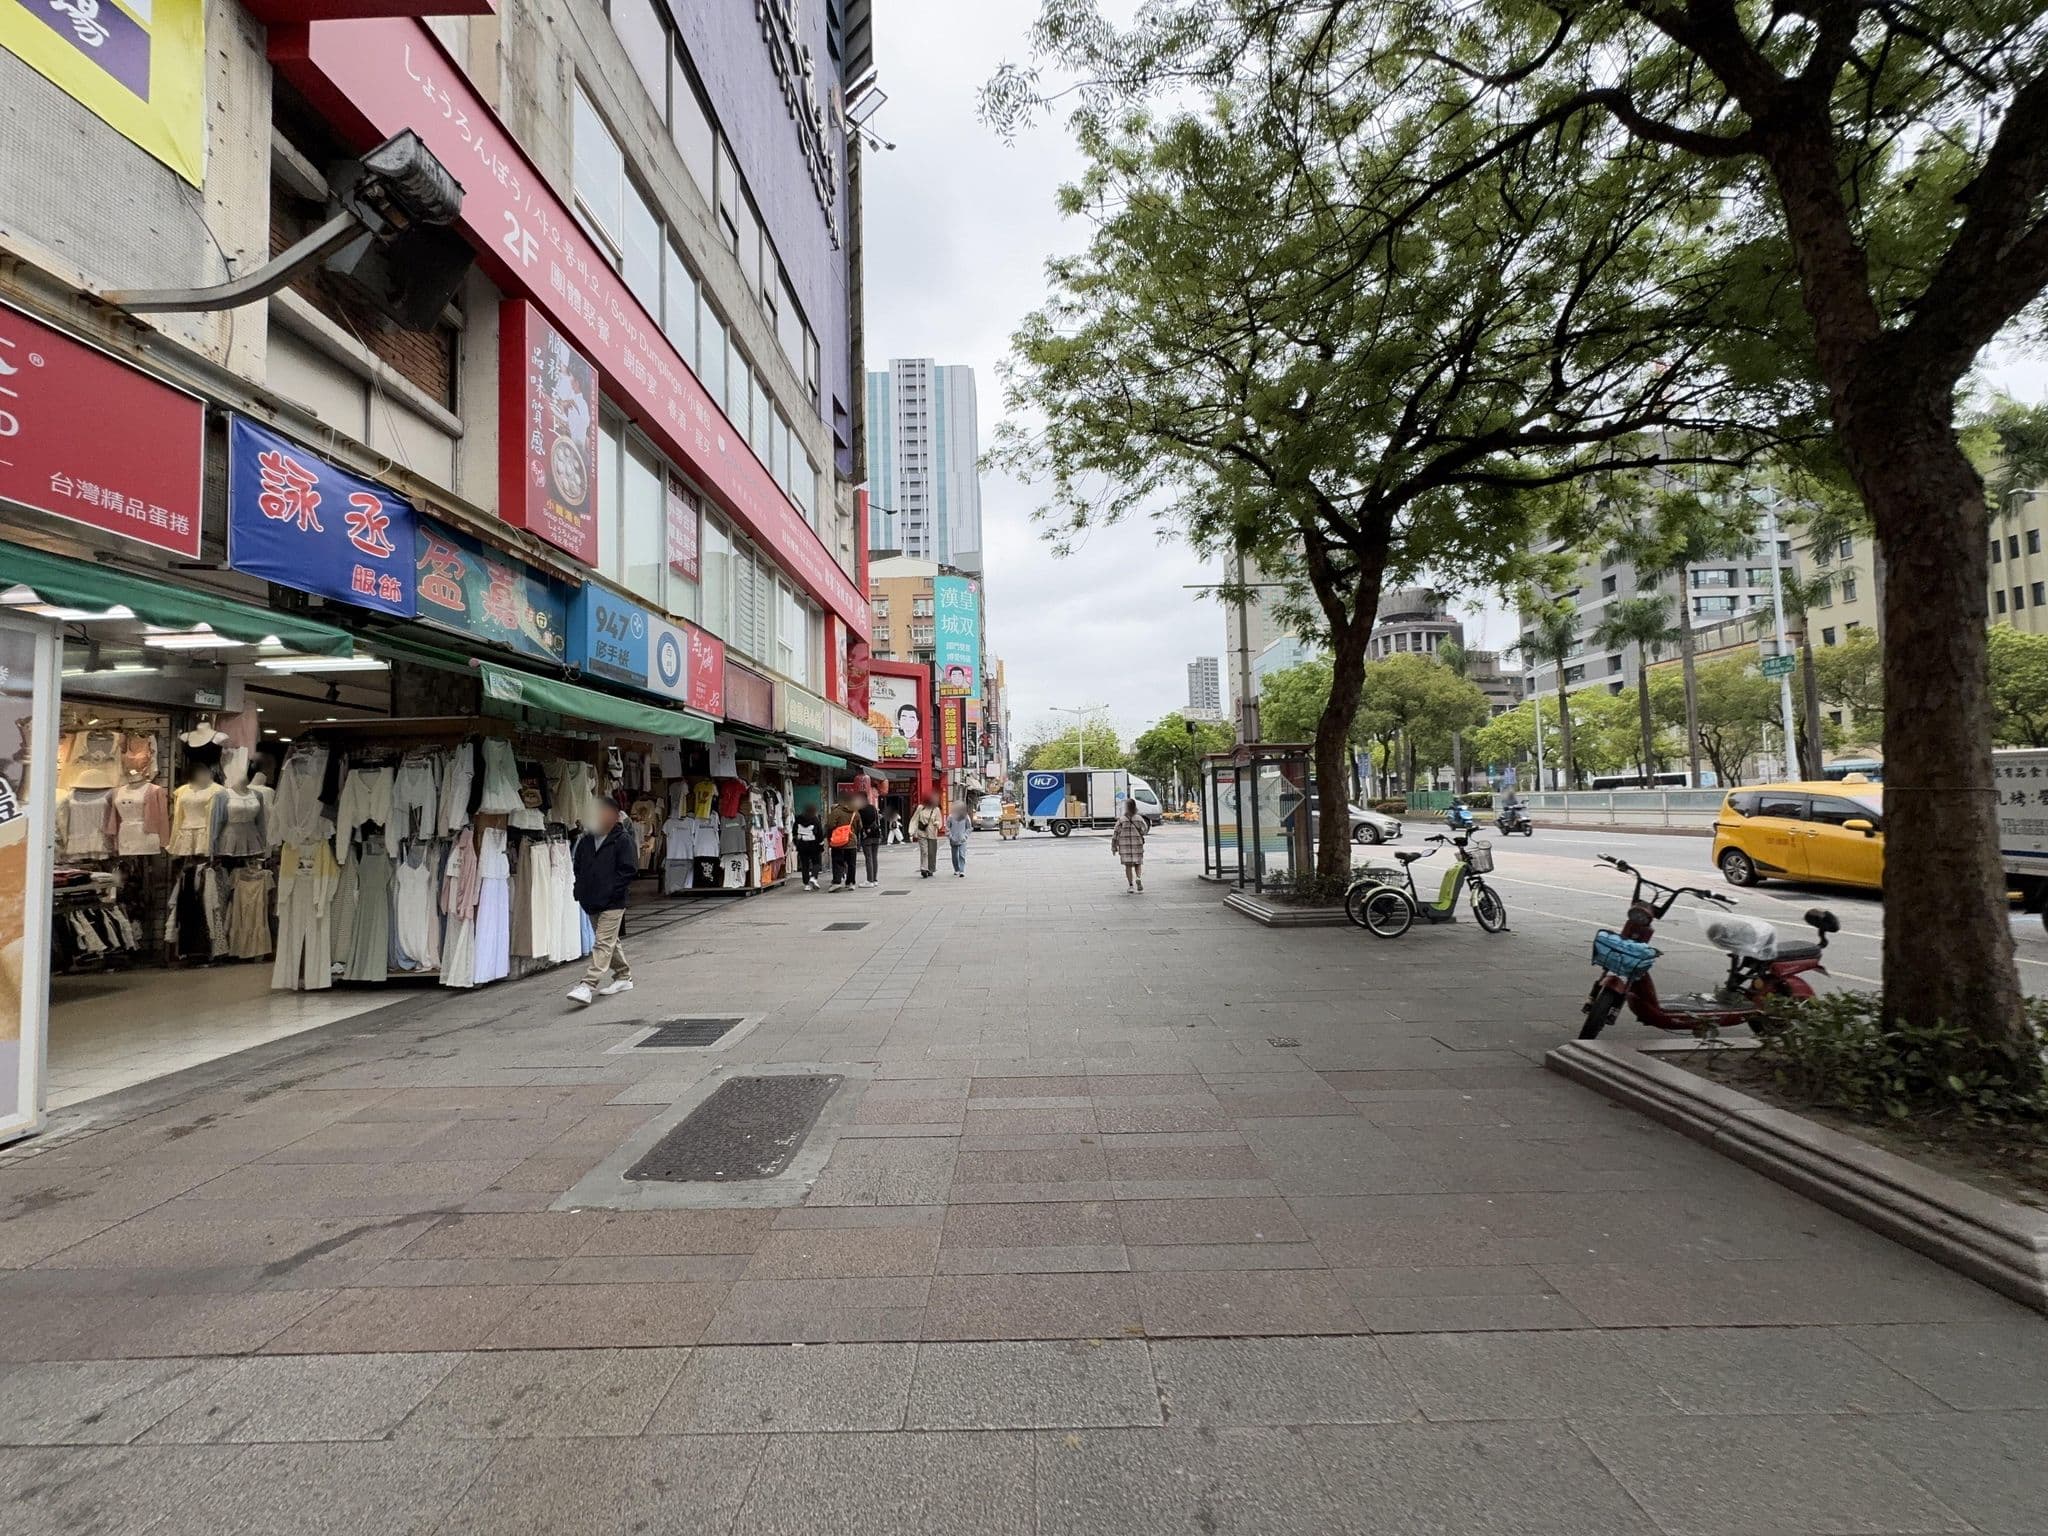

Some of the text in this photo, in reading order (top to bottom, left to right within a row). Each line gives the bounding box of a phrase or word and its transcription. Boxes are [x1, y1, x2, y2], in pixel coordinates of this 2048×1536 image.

[503, 210, 540, 268] 2F
[611, 298, 684, 395] Soup Dumplings
[530, 345, 546, 456] 品味質感
[49, 471, 191, 536] 台灣精品蛋捲
[257, 450, 396, 559] 詠丞
[351, 564, 403, 603] 服飾
[595, 605, 631, 642] 947
[596, 639, 630, 668] 修手機
